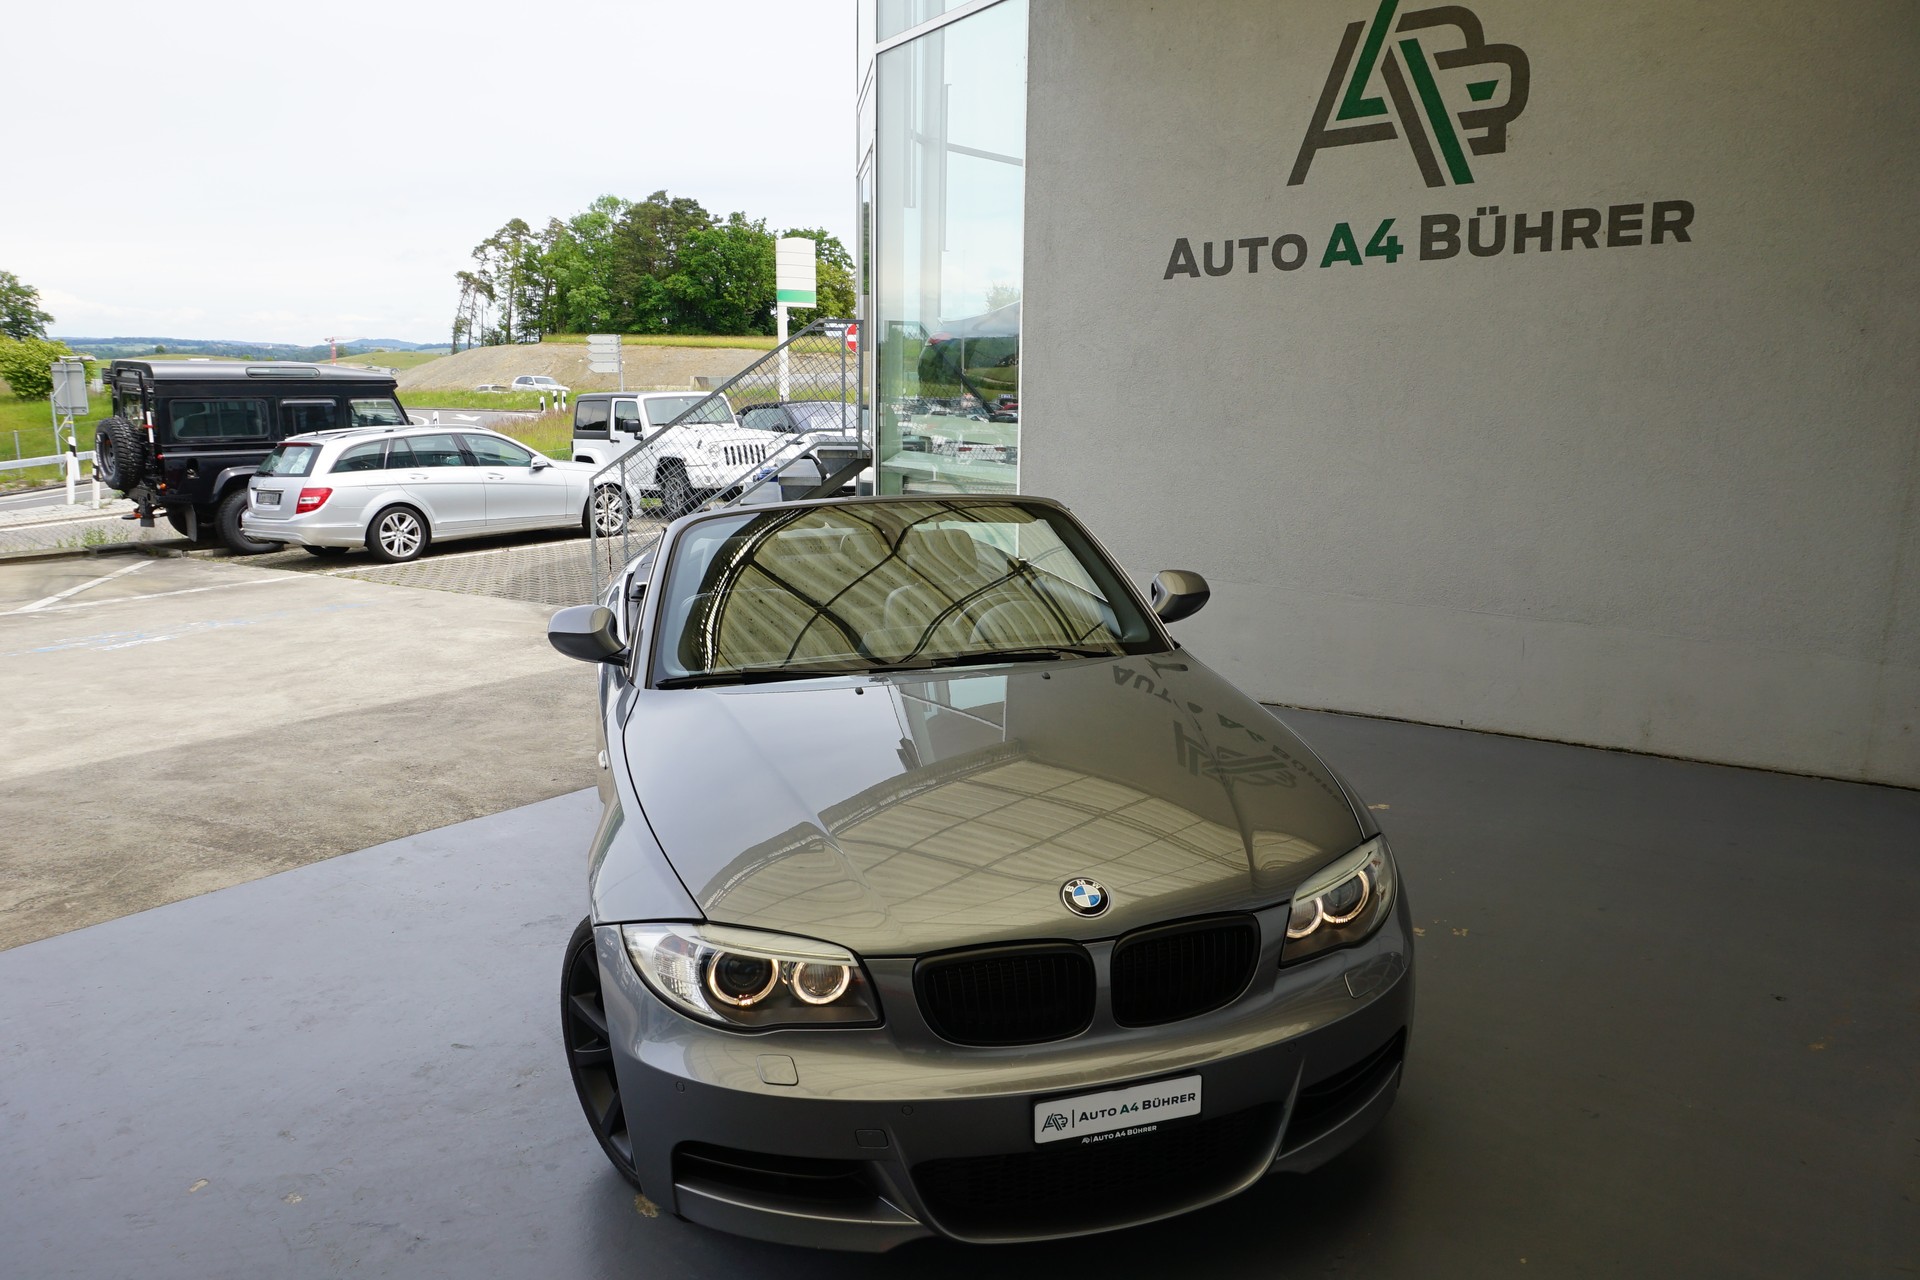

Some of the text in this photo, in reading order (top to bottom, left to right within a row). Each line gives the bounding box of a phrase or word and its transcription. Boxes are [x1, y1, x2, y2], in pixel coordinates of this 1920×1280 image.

[1163, 199, 1696, 280] AUTO A4 BÜHRER
[1065, 879, 1101, 893] BMW
[1078, 1092, 1197, 1123] AUTO A4 BÜHRER
[1092, 1133, 1115, 1143] AUTO
[1115, 1130, 1127, 1138] A4
